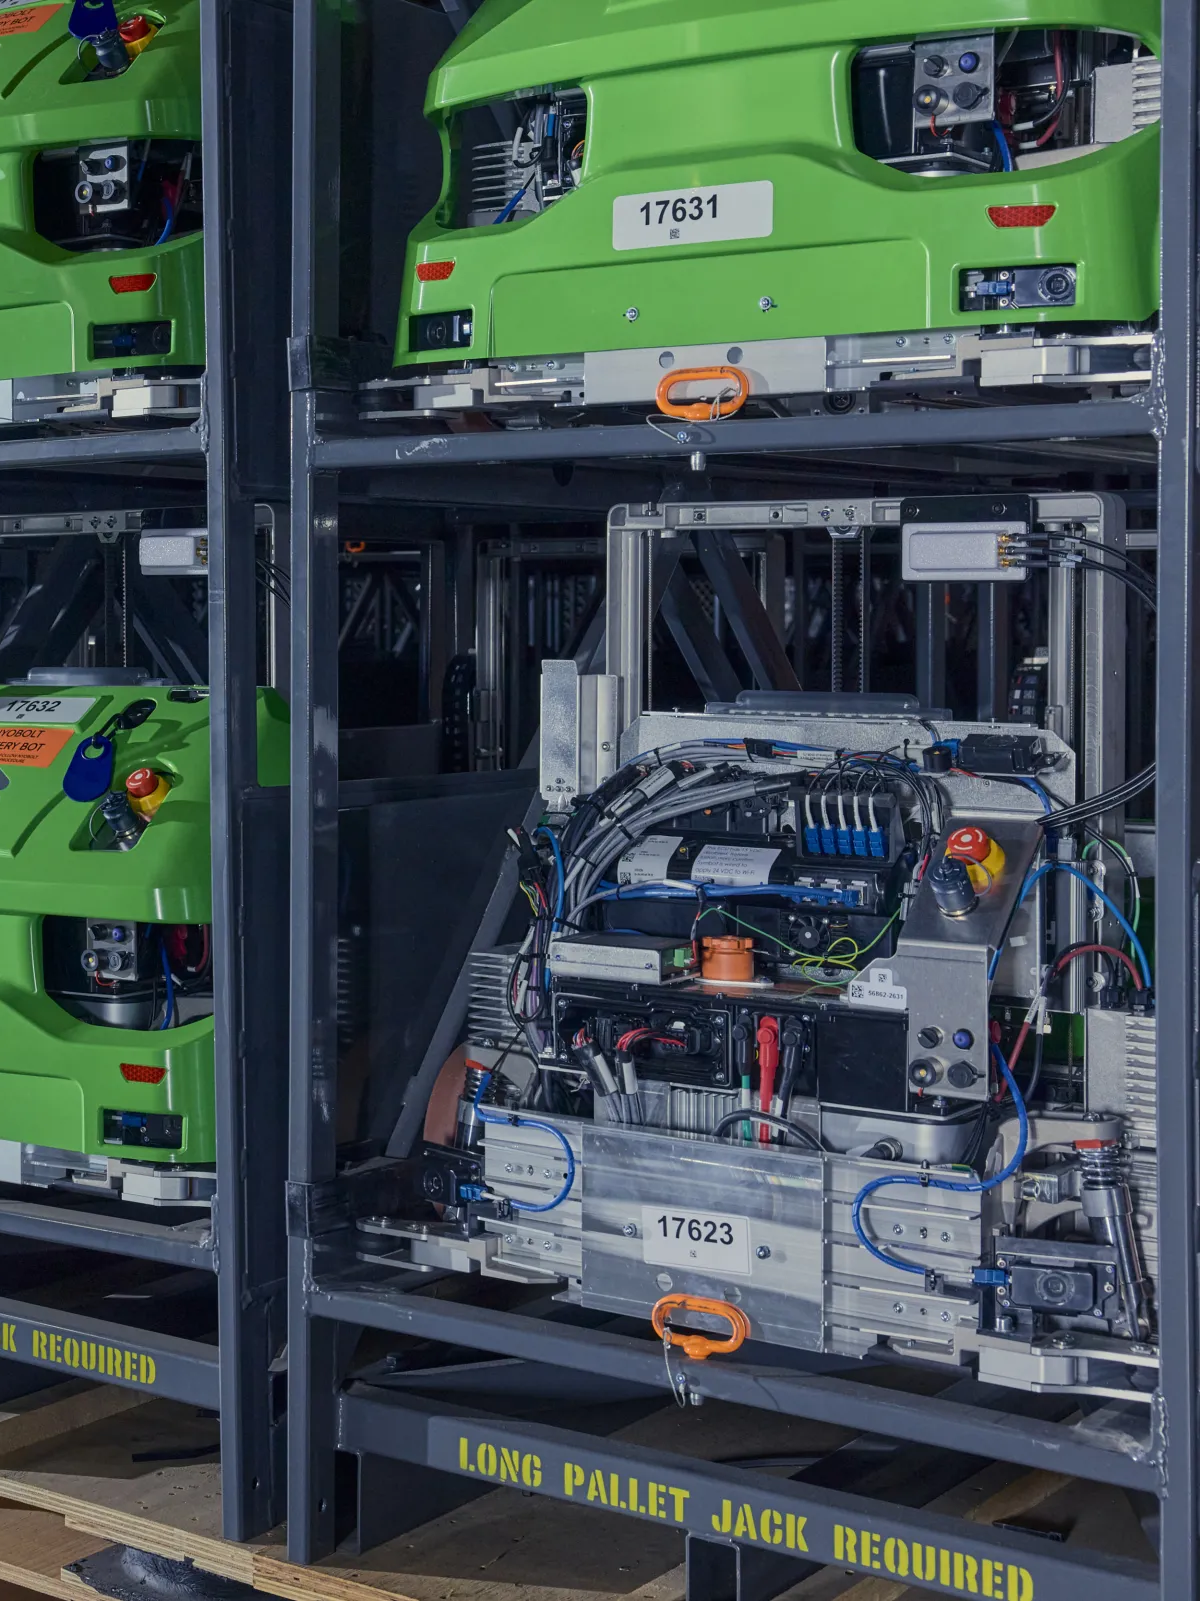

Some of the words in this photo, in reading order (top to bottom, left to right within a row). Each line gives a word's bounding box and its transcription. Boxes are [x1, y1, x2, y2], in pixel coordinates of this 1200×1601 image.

[10, 15, 36, 25] BOT
[640, 194, 717, 225] 17631
[6, 700, 61, 712] 17632
[19, 743, 46, 752] BOT
[658, 1215, 734, 1245] 17623
[32, 1329, 156, 1385] REQUIRED
[458, 1437, 542, 1488] LONG
[564, 1462, 690, 1523] PALLET
[711, 1500, 809, 1552] JACK
[833, 1524, 1034, 1601] REQUIRED
